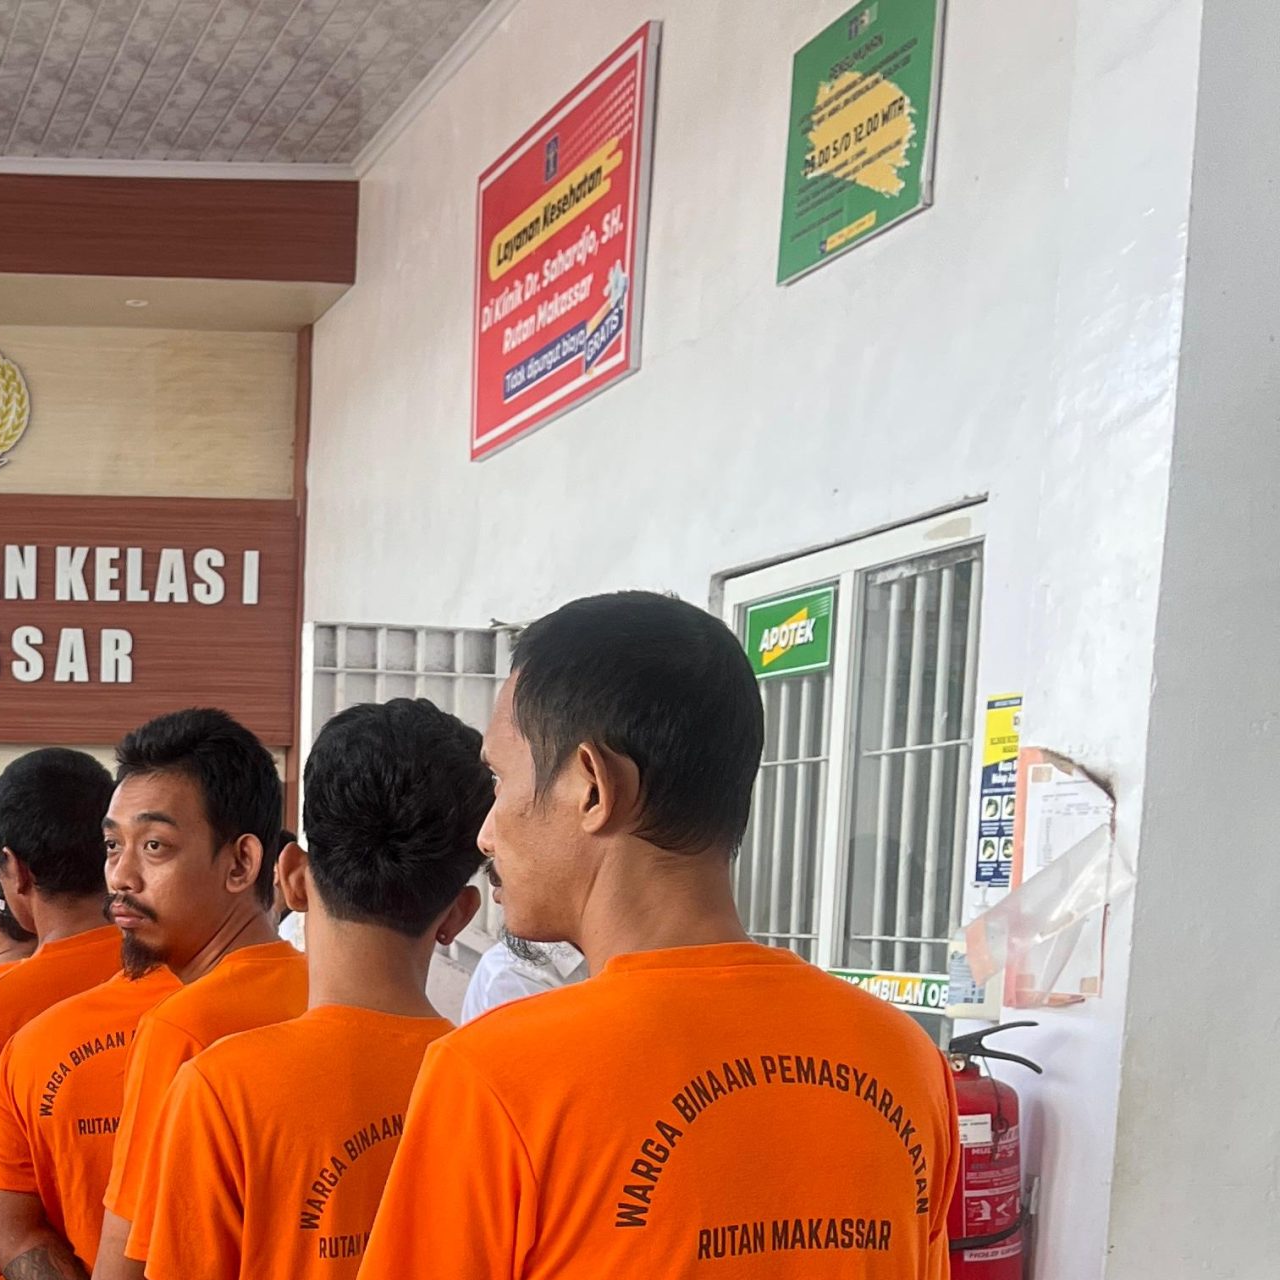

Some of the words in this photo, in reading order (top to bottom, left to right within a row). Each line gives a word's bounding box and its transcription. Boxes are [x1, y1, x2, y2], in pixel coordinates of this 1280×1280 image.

[496, 216, 540, 266] Layanan
[541, 165, 602, 232] Kesehatan
[493, 282, 523, 322] Klinik
[524, 272, 540, 302] Dr.
[502, 314, 536, 355] Rutan
[537, 273, 595, 331] Makassar
[55, 545, 225, 605] KELAS
[241, 549, 261, 605] I
[758, 617, 817, 653] APOTEK
[38, 1061, 70, 1118] WARGA
[69, 1031, 126, 1067] BINAAN
[299, 1155, 348, 1231] WARGA
[343, 1113, 403, 1163] BINAAN
[615, 1119, 684, 1228] WARGA
[671, 1057, 758, 1124] BINAAN
[760, 1054, 929, 1216] PEMASYARAKATAN
[697, 1221, 765, 1261] RUTAN
[772, 1217, 892, 1252] MAKASSAR
